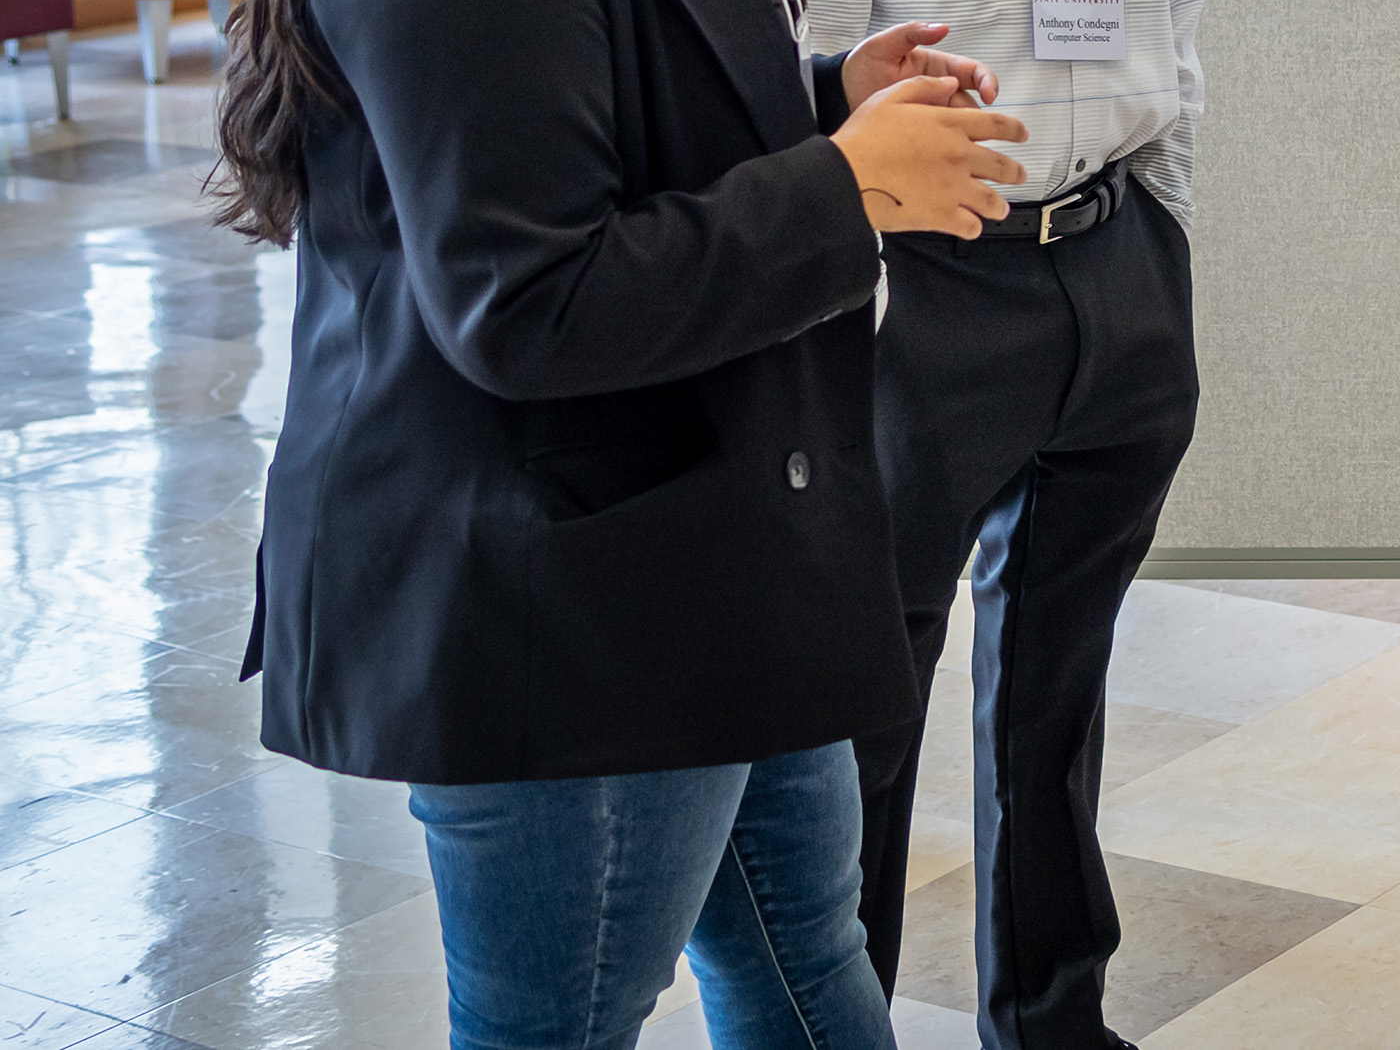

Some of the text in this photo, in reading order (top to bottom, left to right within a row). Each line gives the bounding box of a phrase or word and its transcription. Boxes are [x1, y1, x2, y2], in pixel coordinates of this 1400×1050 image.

[1038, 17, 1119, 31] Anthony Condegni
[1047, 32, 1111, 44] Computer Science
